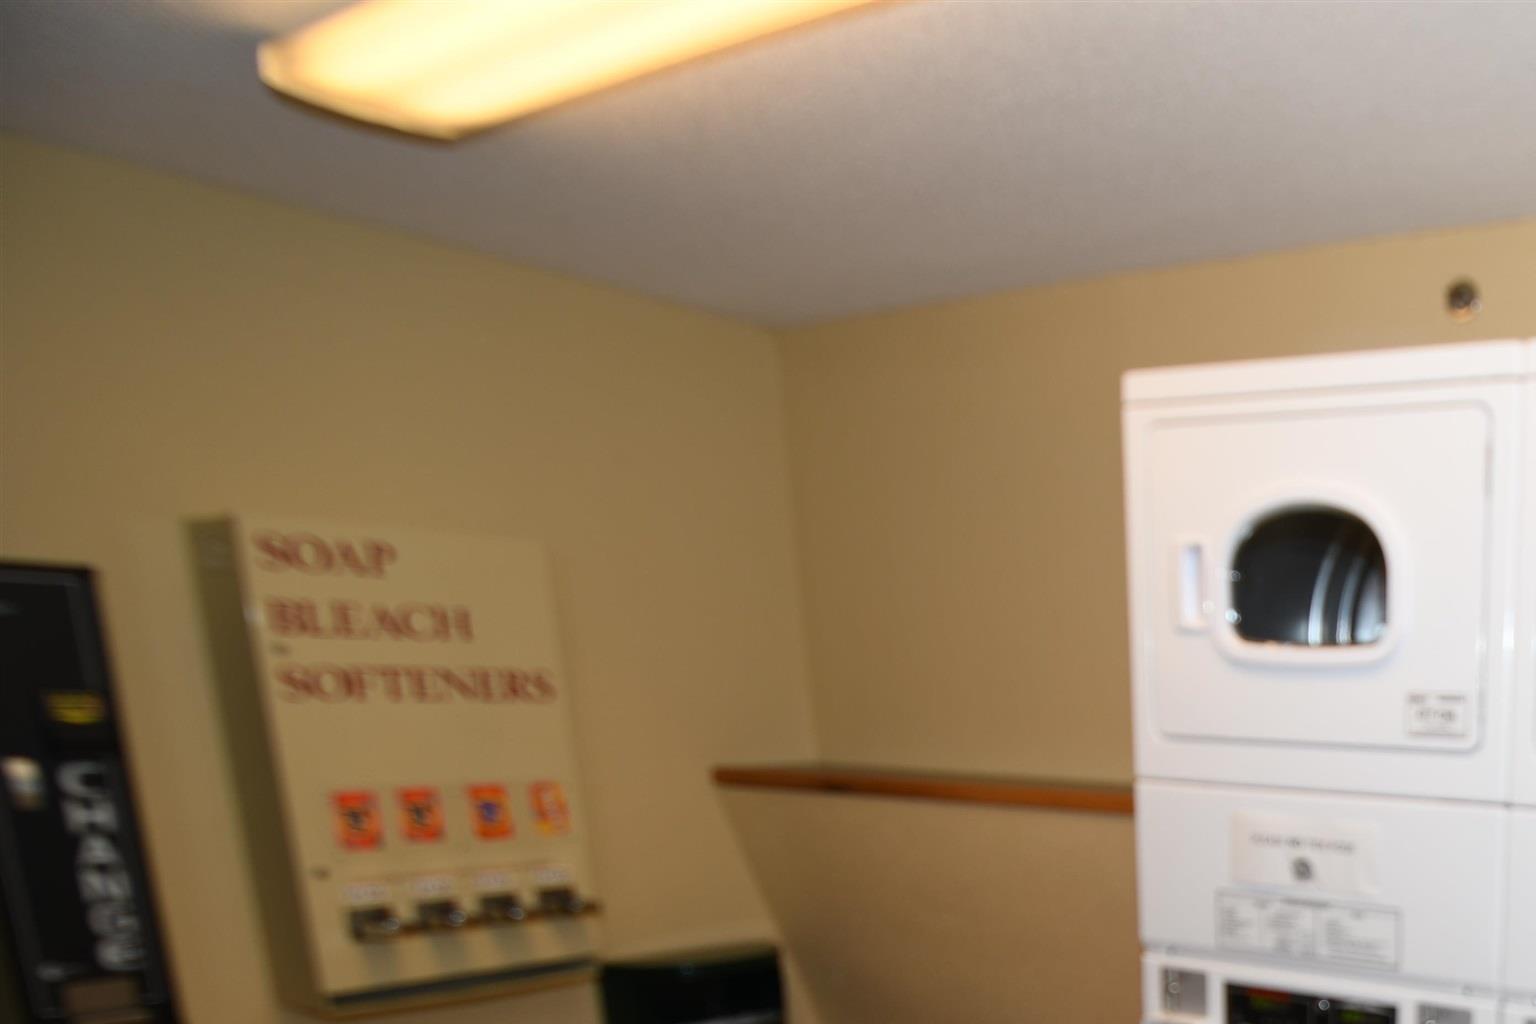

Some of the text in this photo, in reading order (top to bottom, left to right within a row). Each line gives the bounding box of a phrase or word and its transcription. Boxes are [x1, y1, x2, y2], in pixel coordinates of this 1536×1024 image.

[251, 529, 398, 579] SOAP
[262, 596, 476, 644] BLEACH
[273, 662, 559, 705] SOFTENERS
[55, 759, 147, 971] CHANGE
